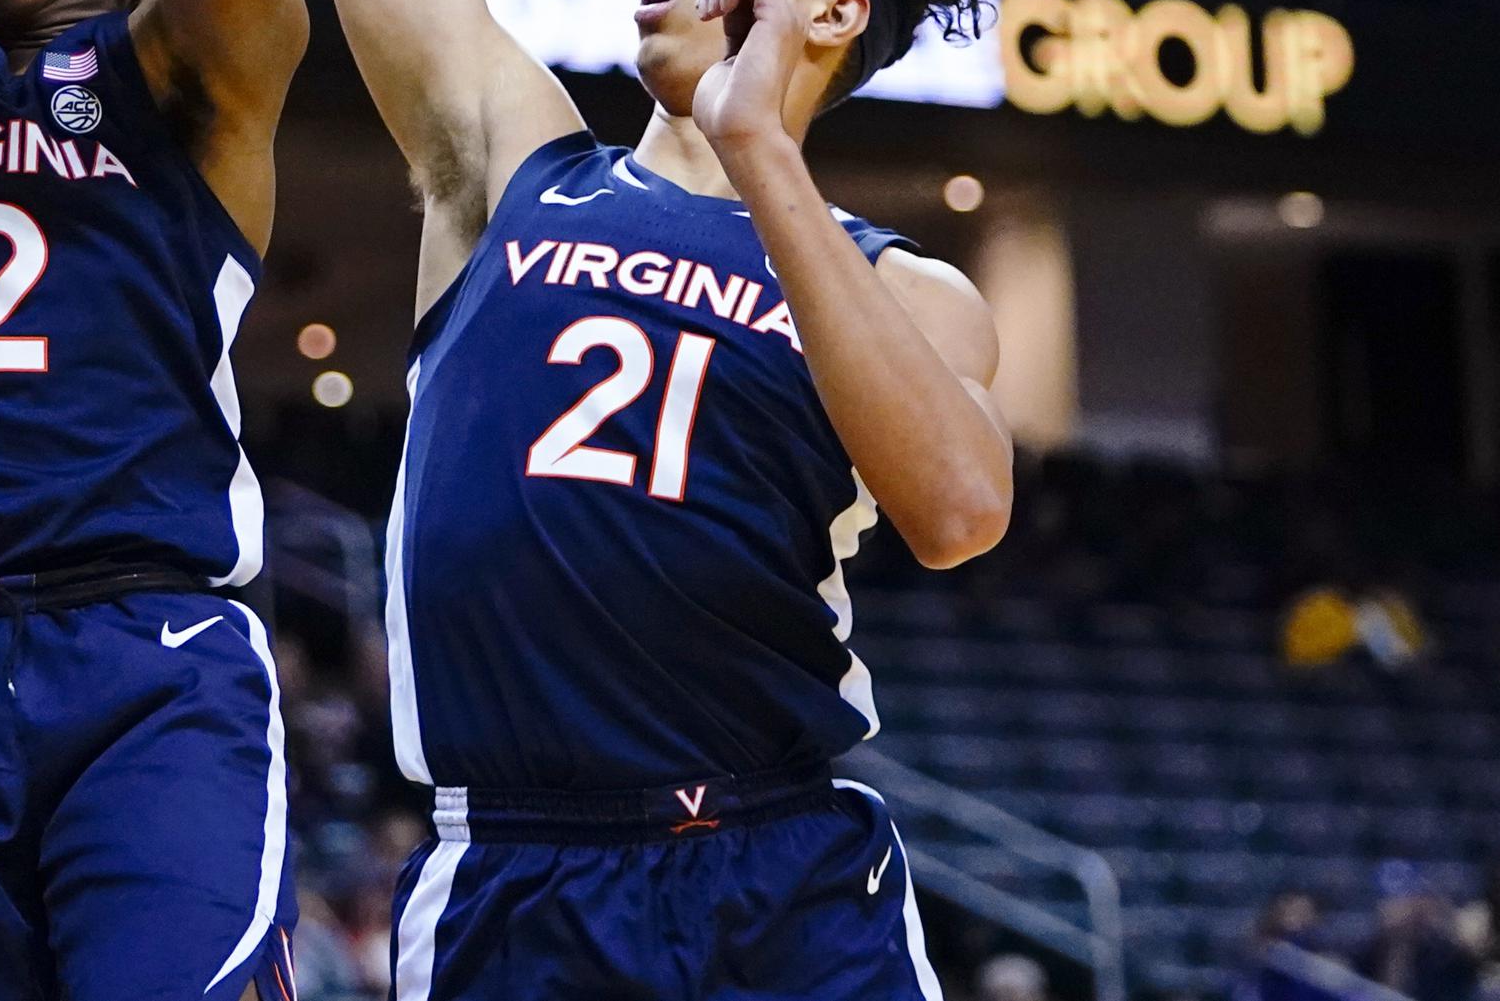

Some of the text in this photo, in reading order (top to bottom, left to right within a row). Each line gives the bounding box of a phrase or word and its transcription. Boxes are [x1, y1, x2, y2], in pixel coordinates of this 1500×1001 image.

[60, 100, 96, 112] ACC
[504, 239, 805, 357] VIRGINIA
[525, 315, 717, 502] 21
[674, 785, 707, 819] V
